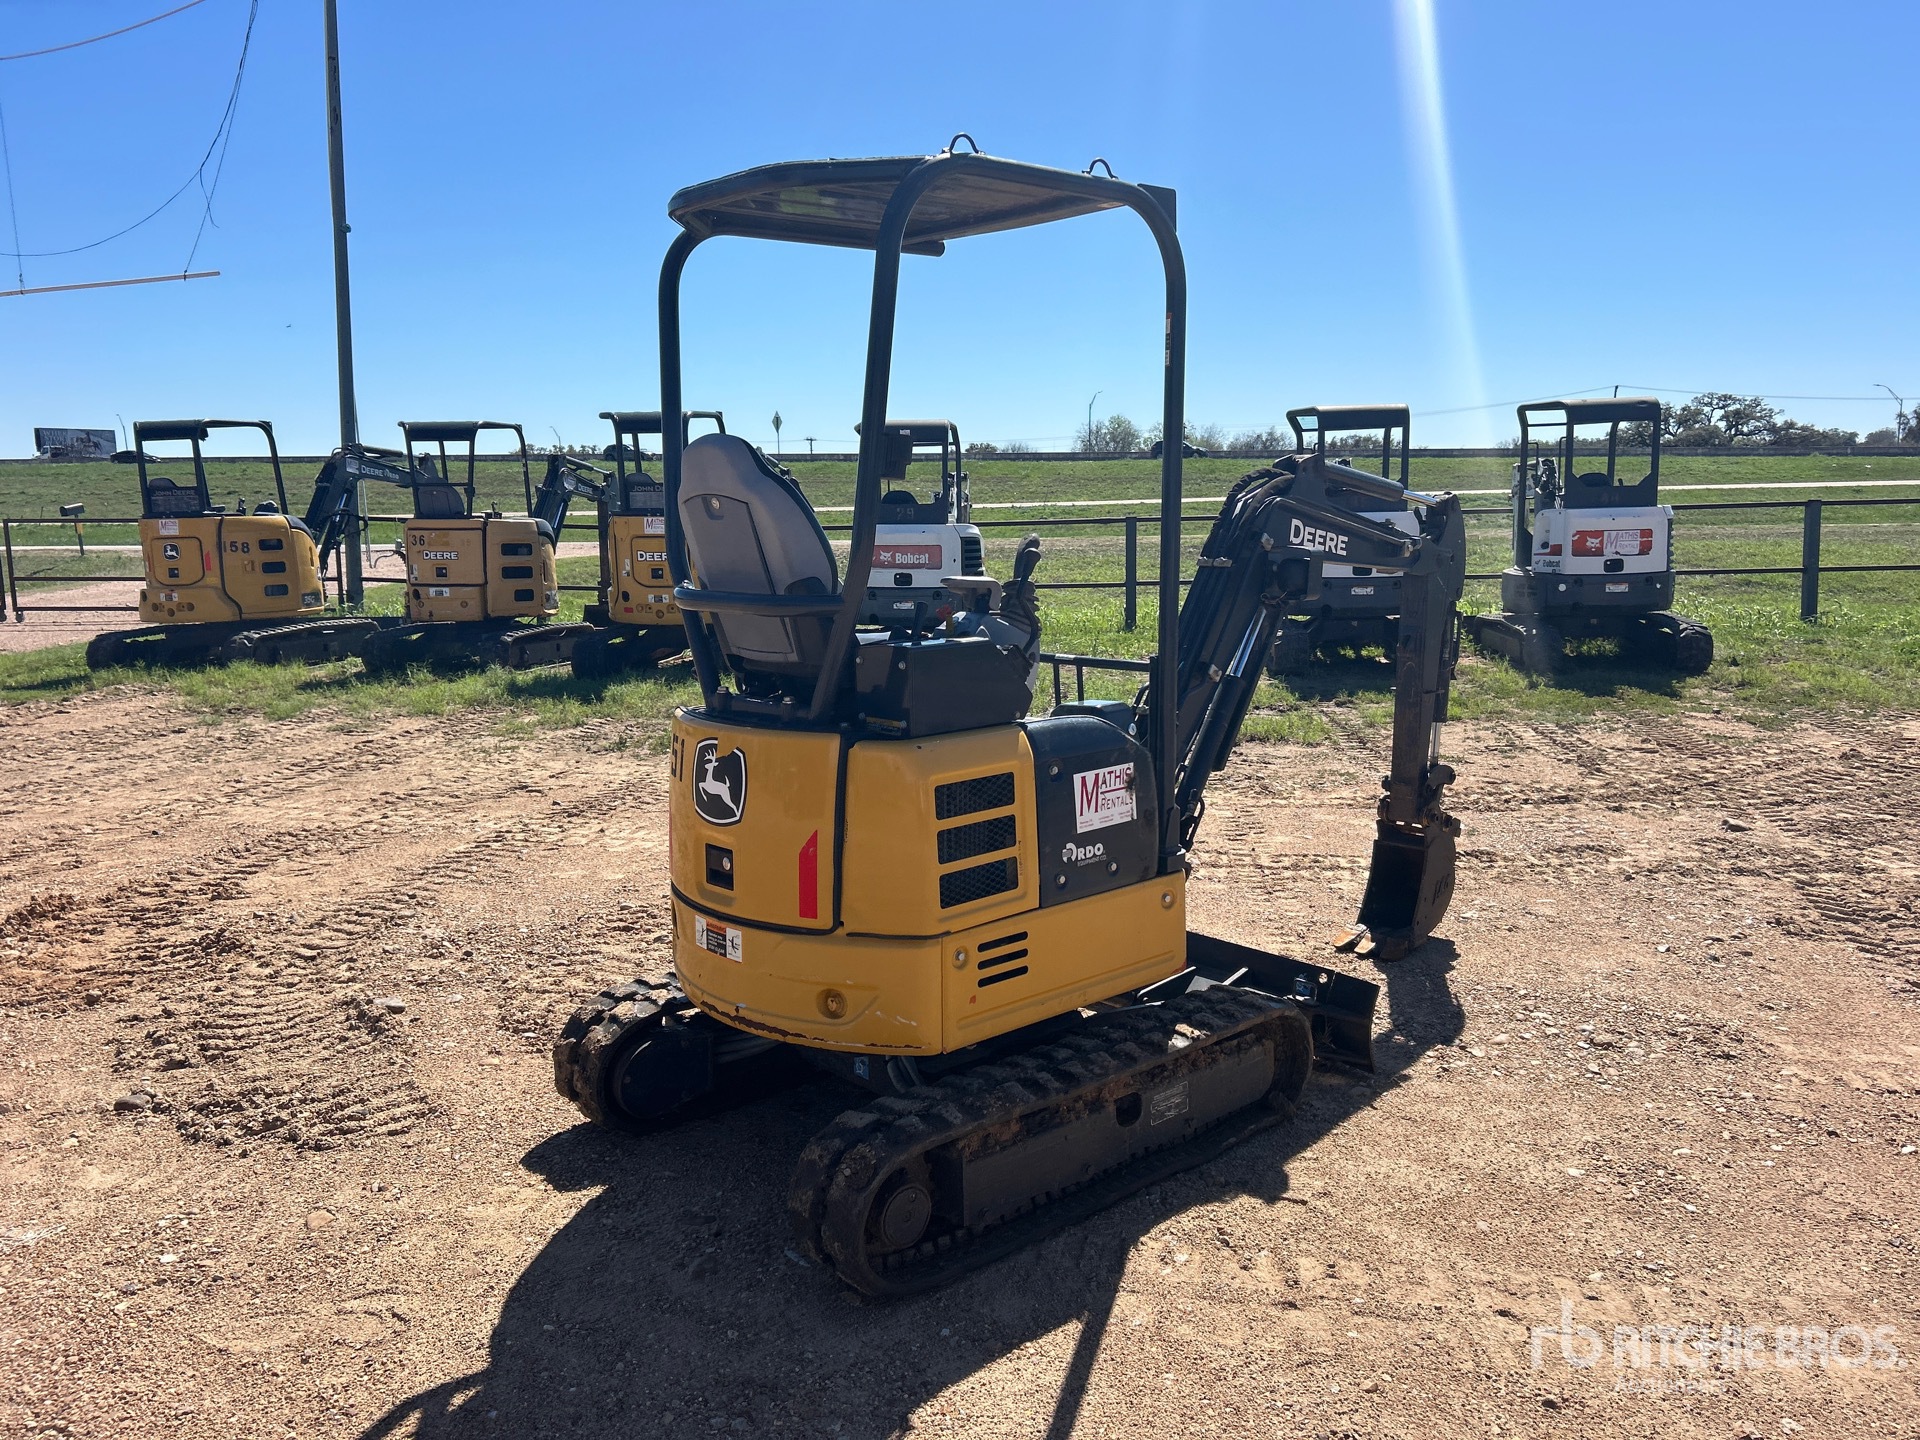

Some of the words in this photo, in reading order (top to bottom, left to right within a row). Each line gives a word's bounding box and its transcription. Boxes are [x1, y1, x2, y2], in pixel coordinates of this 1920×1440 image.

[361, 465, 383, 477] DEERE
[411, 534, 425, 546] 36
[1289, 518, 1349, 556] DEERE
[1604, 532, 1639, 550] MATHIS
[423, 550, 458, 561] DEERE
[637, 550, 667, 561] DEER
[895, 552, 929, 564] Bobcat
